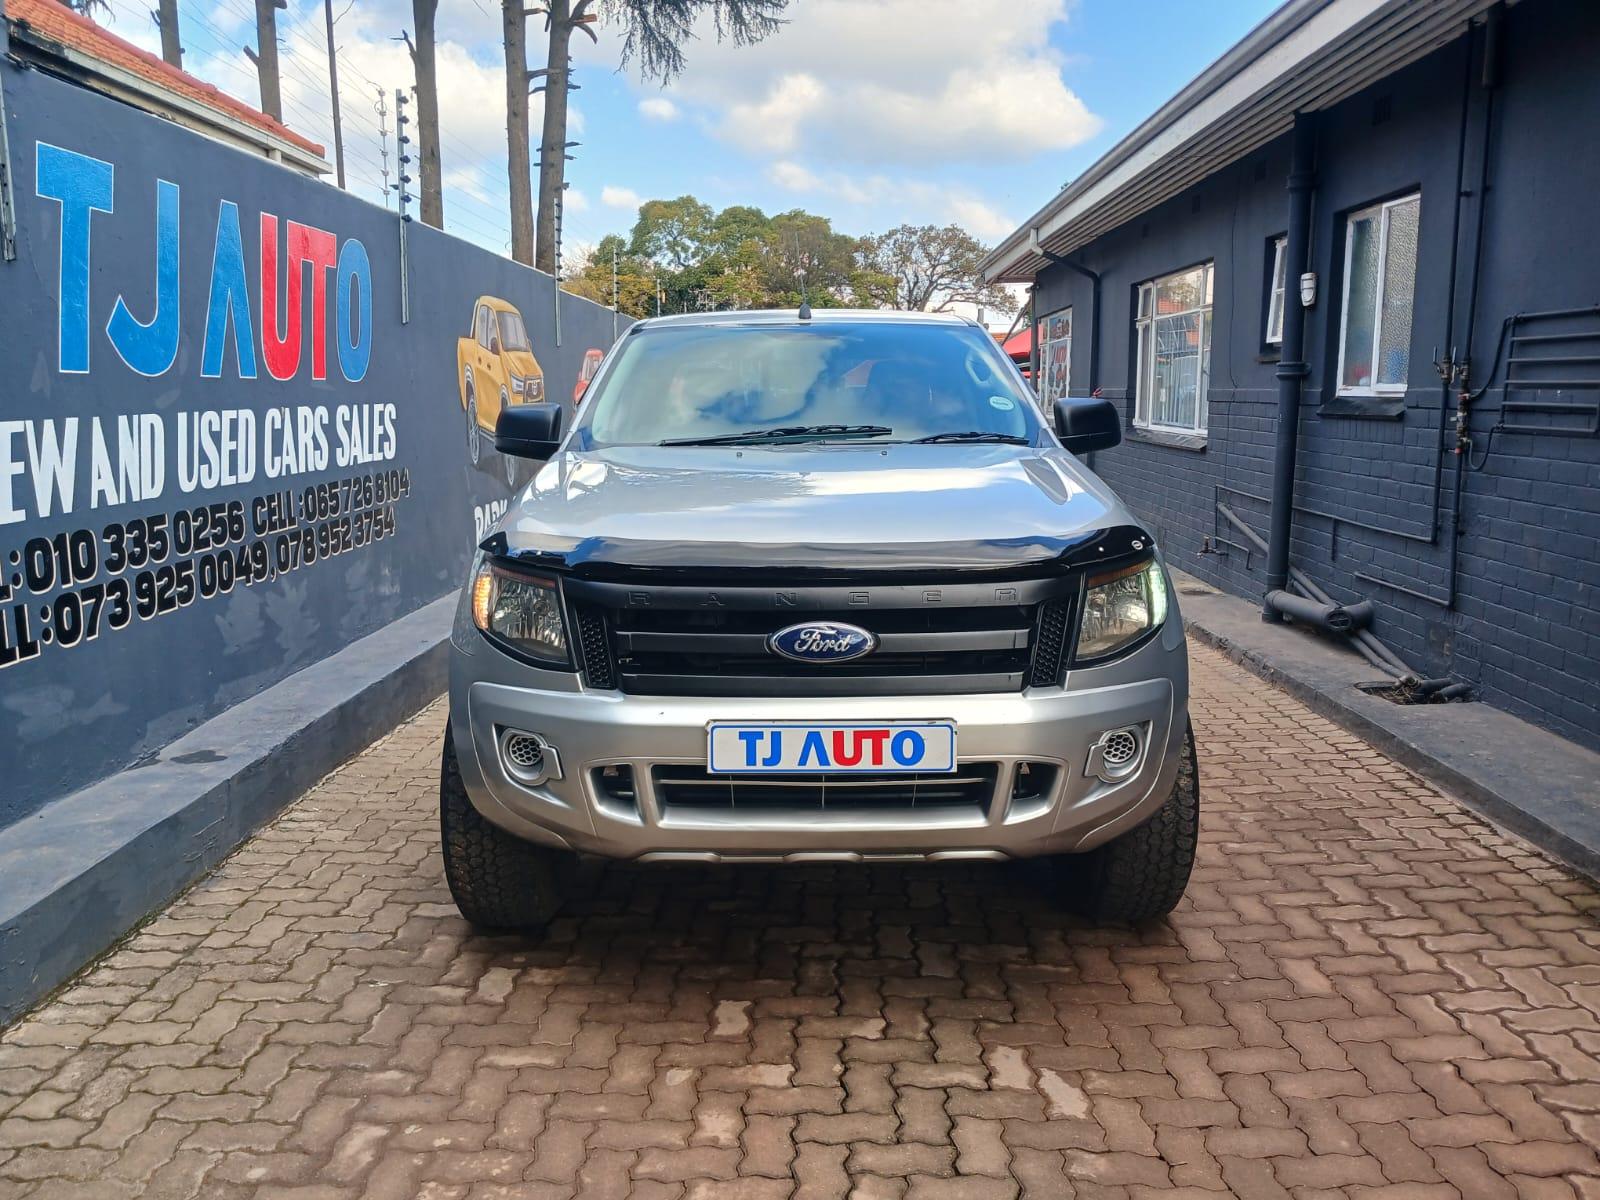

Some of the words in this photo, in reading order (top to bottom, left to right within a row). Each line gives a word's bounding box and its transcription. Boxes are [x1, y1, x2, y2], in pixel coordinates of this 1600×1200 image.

[36, 141, 180, 377] TJ
[200, 199, 373, 383] AUTO
[90, 412, 165, 509] AND
[178, 408, 256, 493] USED
[264, 405, 329, 478] CARS
[335, 402, 398, 468] SALES
[103, 513, 169, 575] 335
[173, 500, 245, 556] 0256
[342, 475, 373, 514] 726
[375, 467, 411, 505] 8104
[135, 559, 196, 620] 925
[318, 515, 354, 560] 952
[354, 505, 396, 548] 3754
[628, 586, 1019, 606] RANGER
[793, 628, 853, 654] Ford
[738, 731, 782, 767] TJ
[798, 730, 926, 767] AUTO
